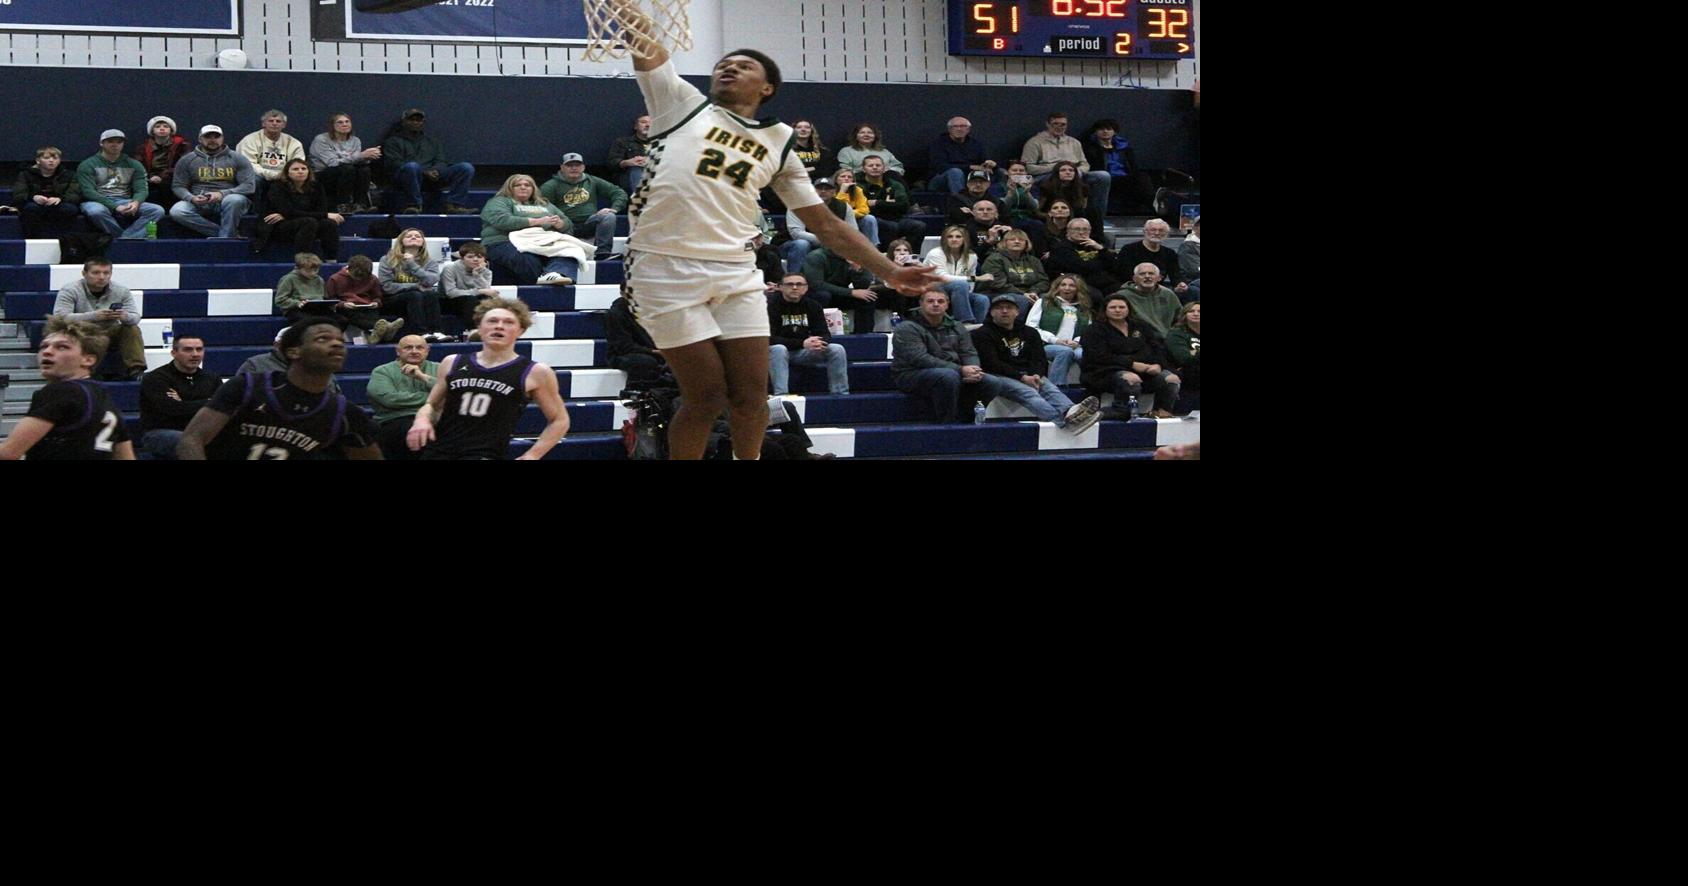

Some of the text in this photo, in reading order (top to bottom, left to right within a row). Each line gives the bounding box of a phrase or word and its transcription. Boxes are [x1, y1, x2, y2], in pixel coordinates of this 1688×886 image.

[973, 3, 1018, 33] 51
[1147, 8, 1188, 38] 32
[993, 38, 1004, 49] B
[1059, 33, 1131, 54] period 2
[704, 126, 770, 162] IRISH
[198, 166, 234, 178] IRISH
[695, 148, 755, 190] 24
[450, 378, 514, 395] STOUGHTON
[459, 391, 492, 417] 10
[94, 410, 118, 451] 2
[240, 422, 321, 452] STOUGHTON
